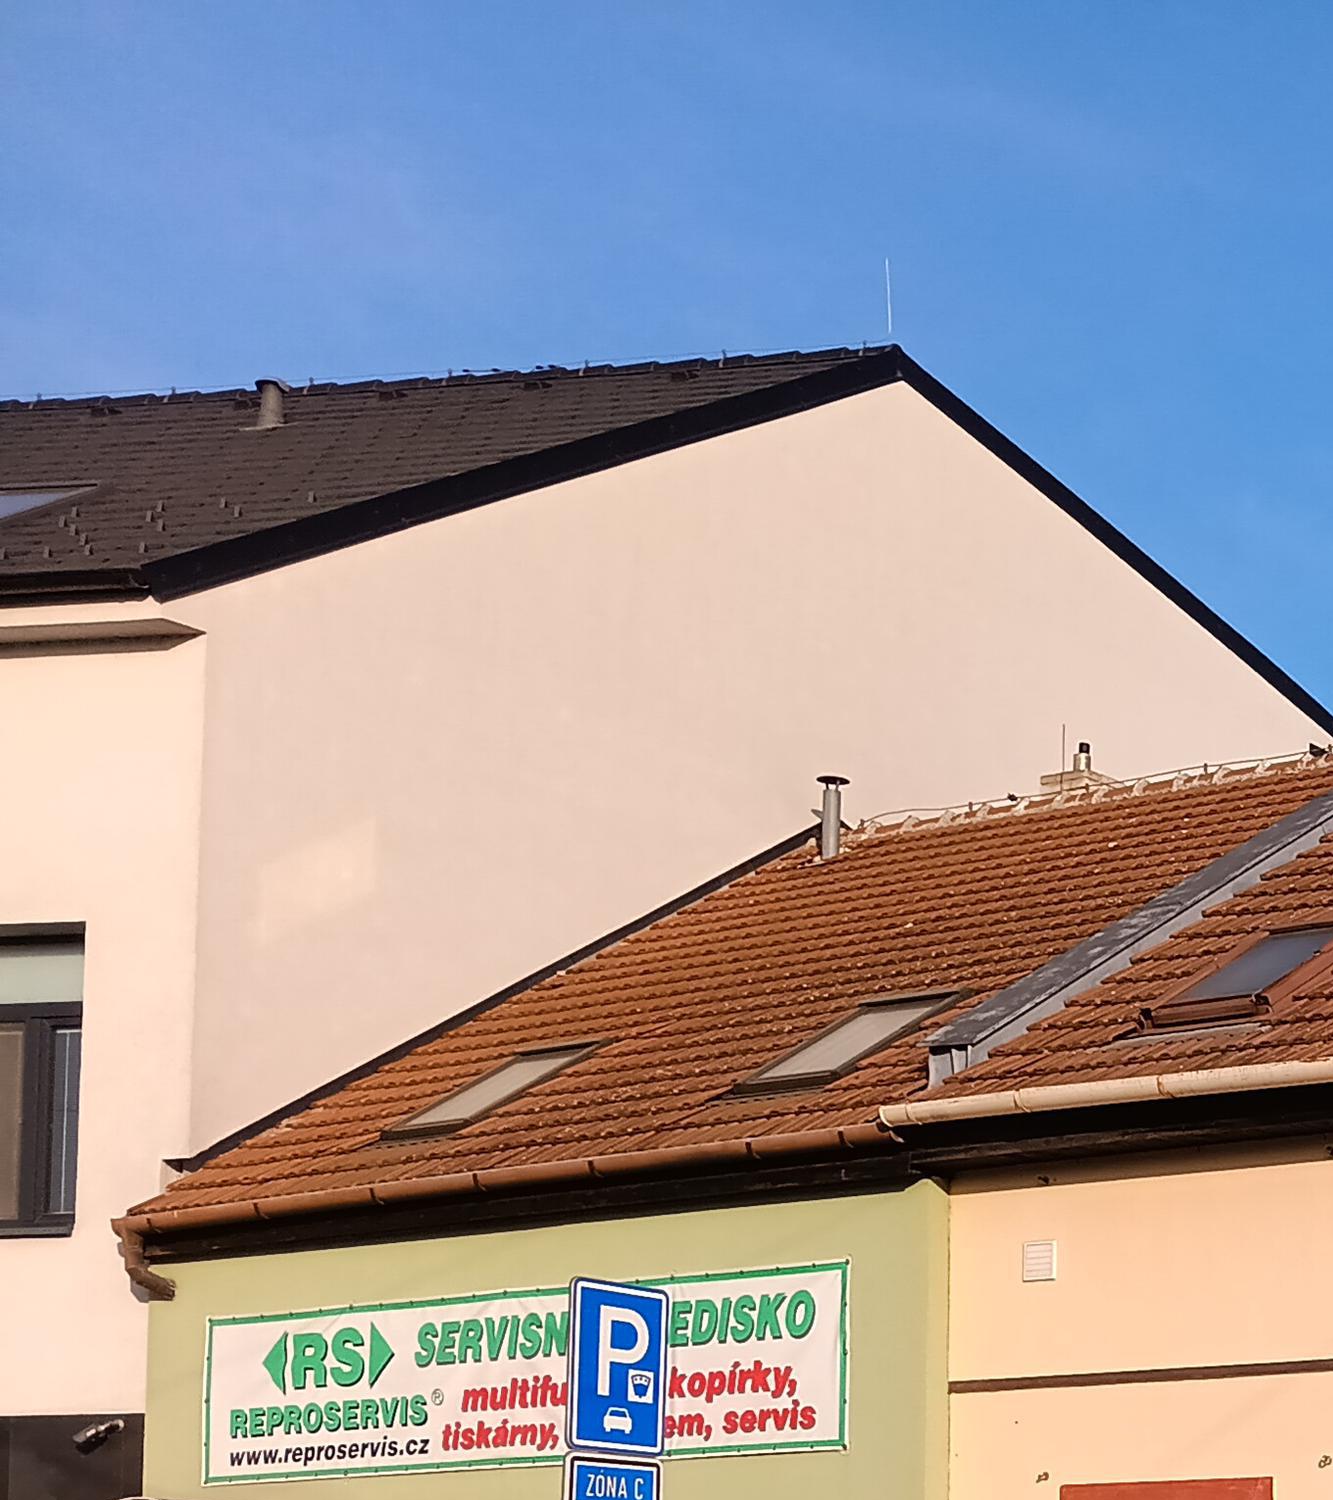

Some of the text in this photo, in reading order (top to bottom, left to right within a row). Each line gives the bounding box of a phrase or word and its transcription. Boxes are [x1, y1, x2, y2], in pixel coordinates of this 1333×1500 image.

[415, 1290, 816, 1368] SERVISN EDISKO
[597, 1304, 649, 1396] P
[291, 1327, 365, 1389] RS
[461, 1360, 797, 1412] multifu kopírky,
[230, 1394, 428, 1439] REPROSERVIS
[442, 1419, 559, 1452] tiskárny,
[722, 1399, 816, 1434] servis
[230, 1436, 430, 1467] www.reproservis.cz
[585, 1469, 644, 1500] ZÓNA C
